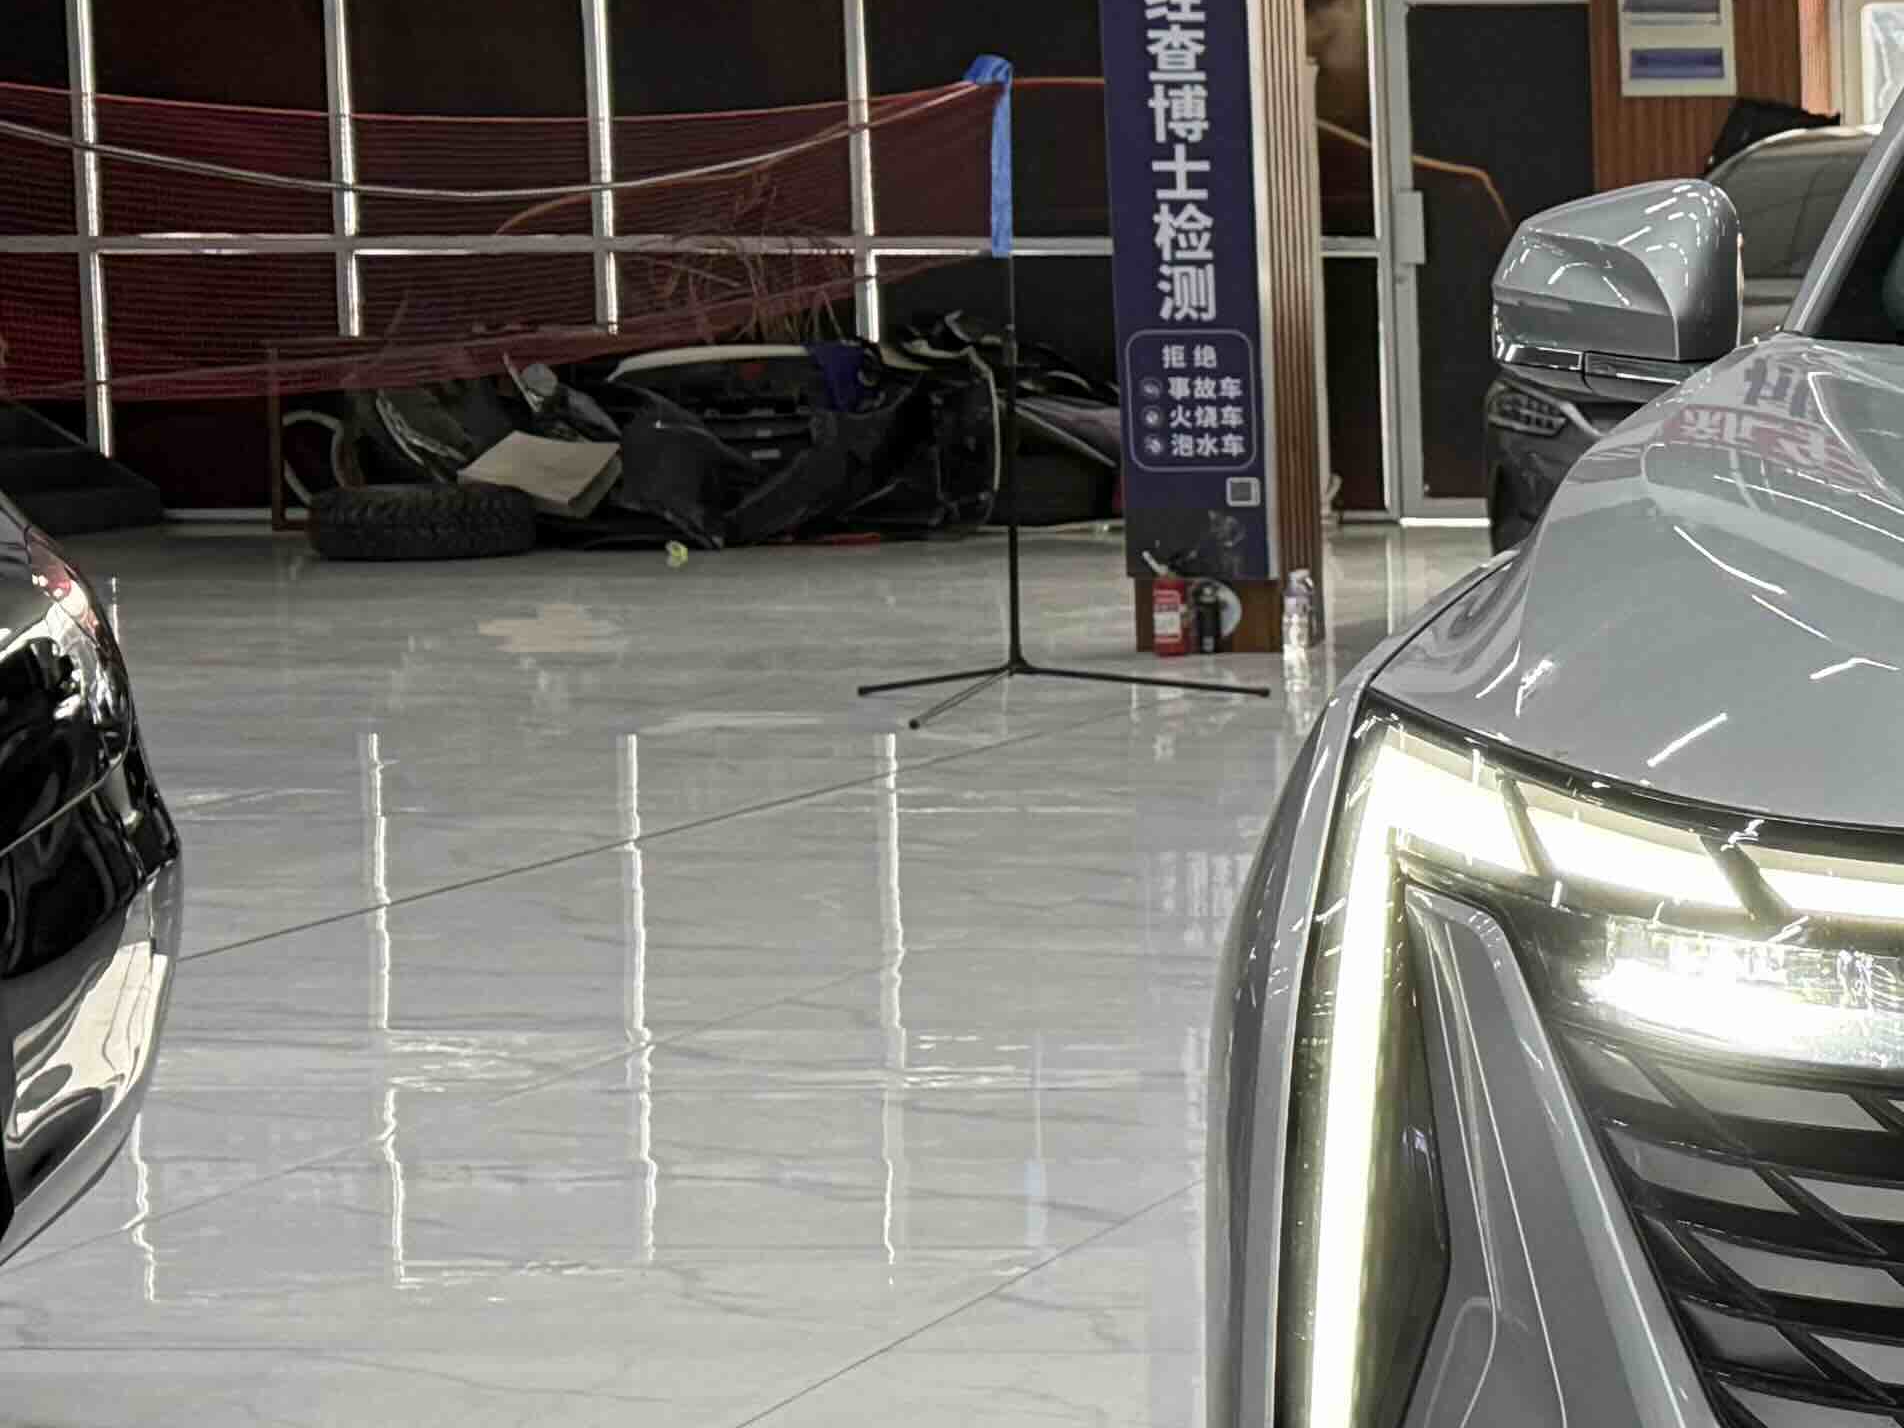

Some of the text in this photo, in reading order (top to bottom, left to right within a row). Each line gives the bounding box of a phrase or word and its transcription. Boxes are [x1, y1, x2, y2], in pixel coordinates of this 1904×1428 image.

[1161, 343, 1218, 370] 拒绝
[1166, 376, 1243, 399] 事故车
[1169, 405, 1245, 429] 火烧车
[1171, 433, 1246, 458] 泡水车
